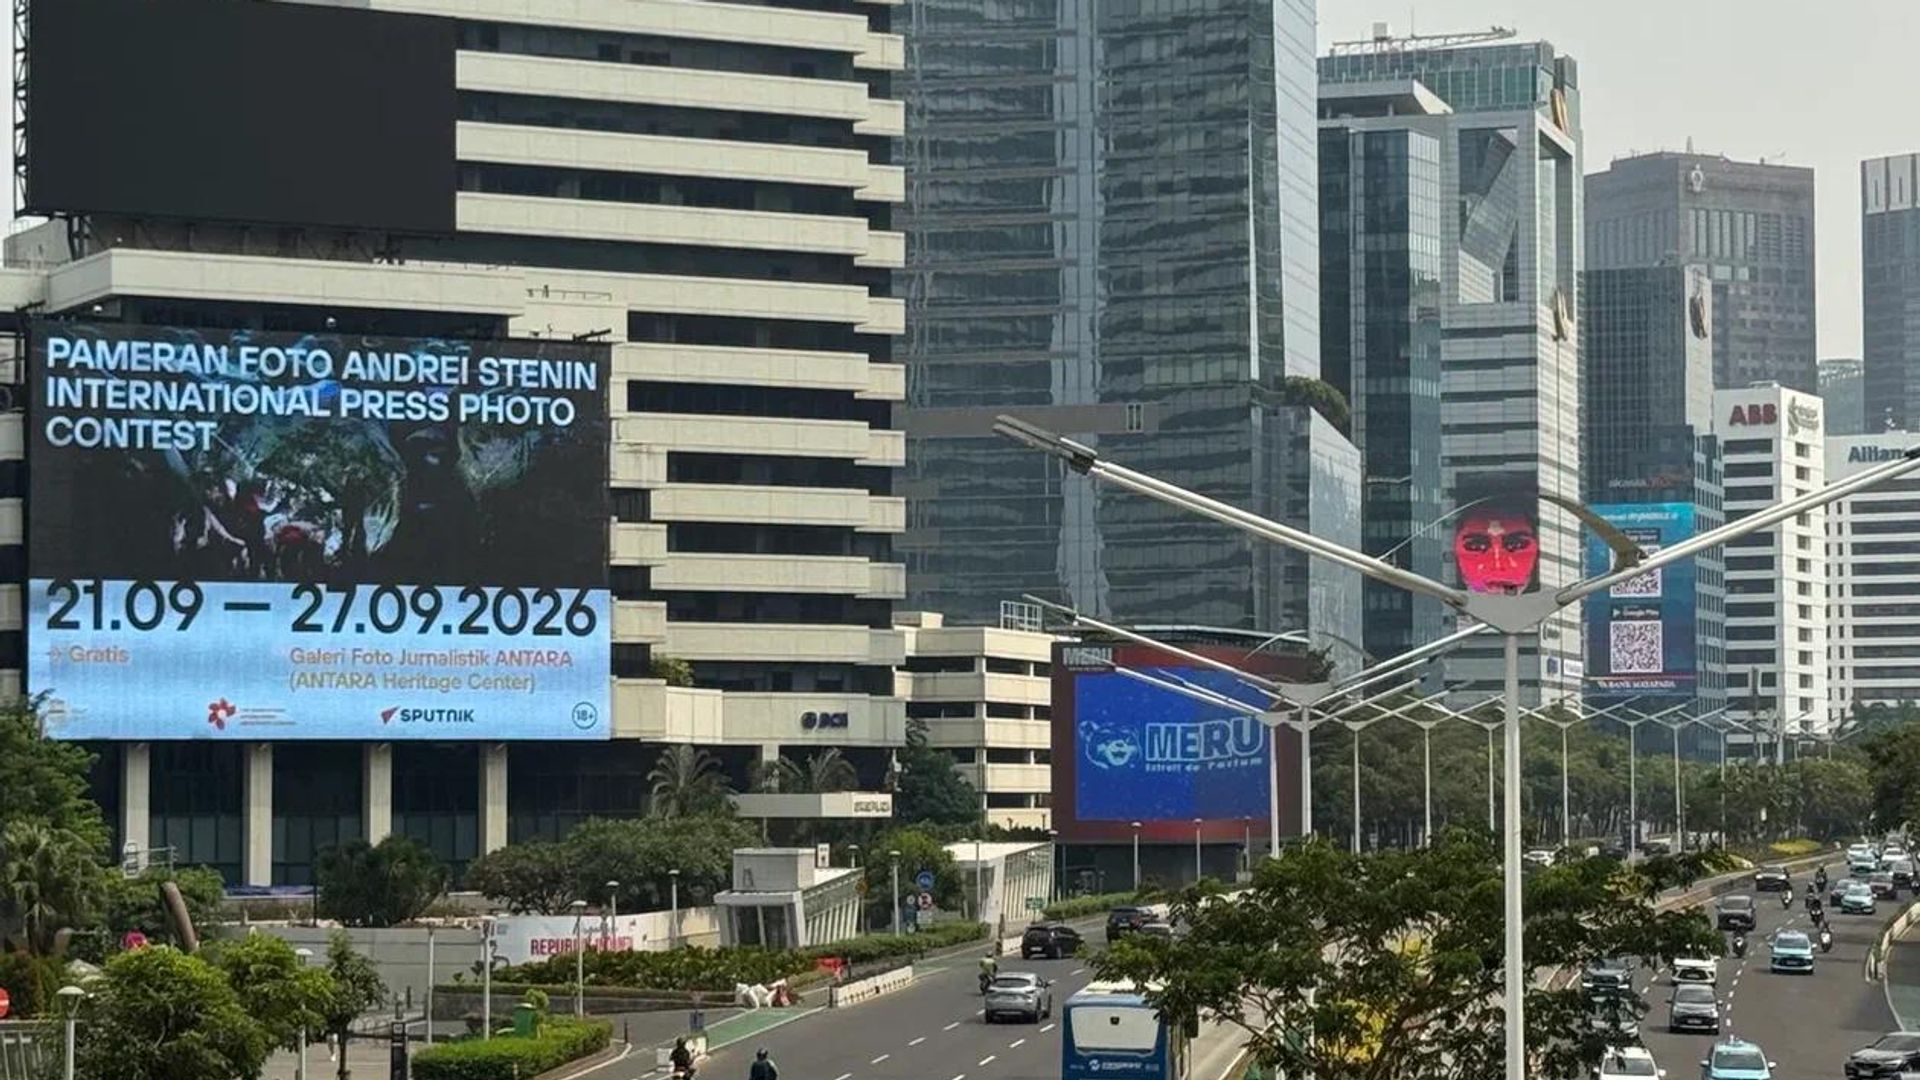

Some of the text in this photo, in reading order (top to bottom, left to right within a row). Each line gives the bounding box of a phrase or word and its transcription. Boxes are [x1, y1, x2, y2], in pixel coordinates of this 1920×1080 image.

[47, 338, 597, 391] PAMERAN FOTO ANDREI STENIN
[46, 376, 575, 426] INTERNATIONAL PRESS PHOTO
[1729, 404, 1778, 426] ABB
[46, 416, 217, 451] CONTEST
[1848, 446, 1903, 462] Allian
[47, 578, 204, 631] 21.09
[291, 583, 597, 637] 27.09.2026
[69, 645, 573, 667] Gratis Galeri Foto Jurnalistik ANTARA
[289, 671, 535, 693] (ANTARA Heritage Center)
[400, 709, 595, 722] SPUTNIK 18+
[1145, 717, 1264, 761] MERU
